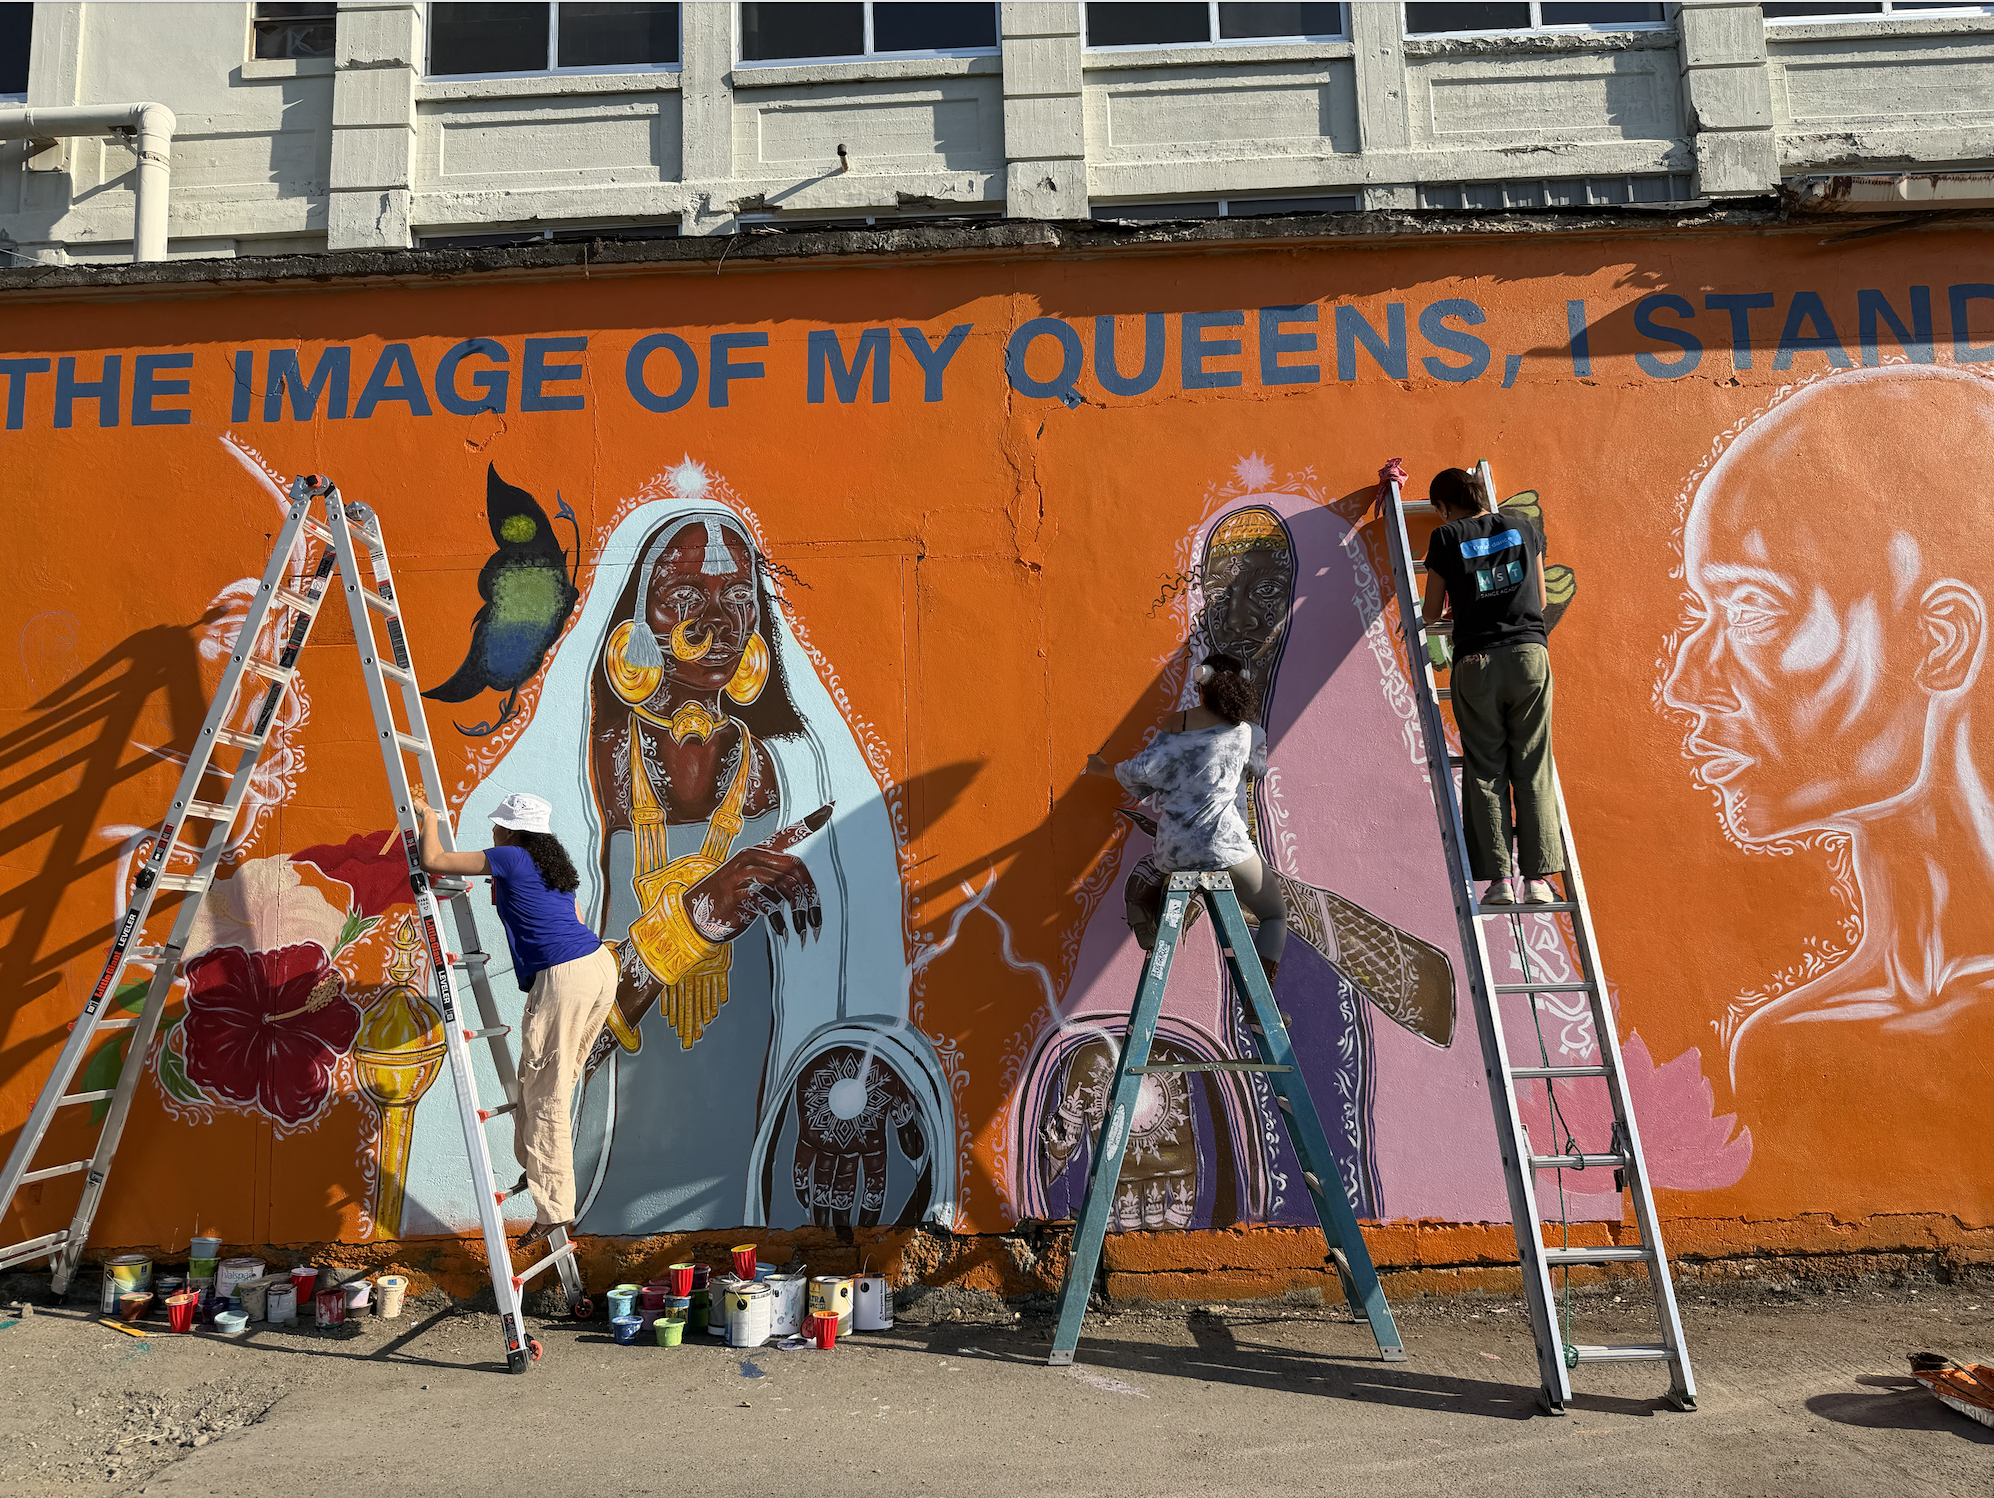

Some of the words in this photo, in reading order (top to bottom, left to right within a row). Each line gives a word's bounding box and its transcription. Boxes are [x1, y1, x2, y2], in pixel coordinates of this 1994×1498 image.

[0, 352, 195, 430] THE
[230, 336, 588, 423] IMAGE
[625, 332, 769, 413] OF
[806, 323, 975, 405] MY
[1005, 298, 1523, 410] QUEENS,
[1565, 298, 1593, 378] I
[1632, 283, 1994, 379] STAND
[1492, 536, 1513, 547] dance
[117, 913, 137, 947] LEVELER
[438, 970, 451, 1005] LEVELER
